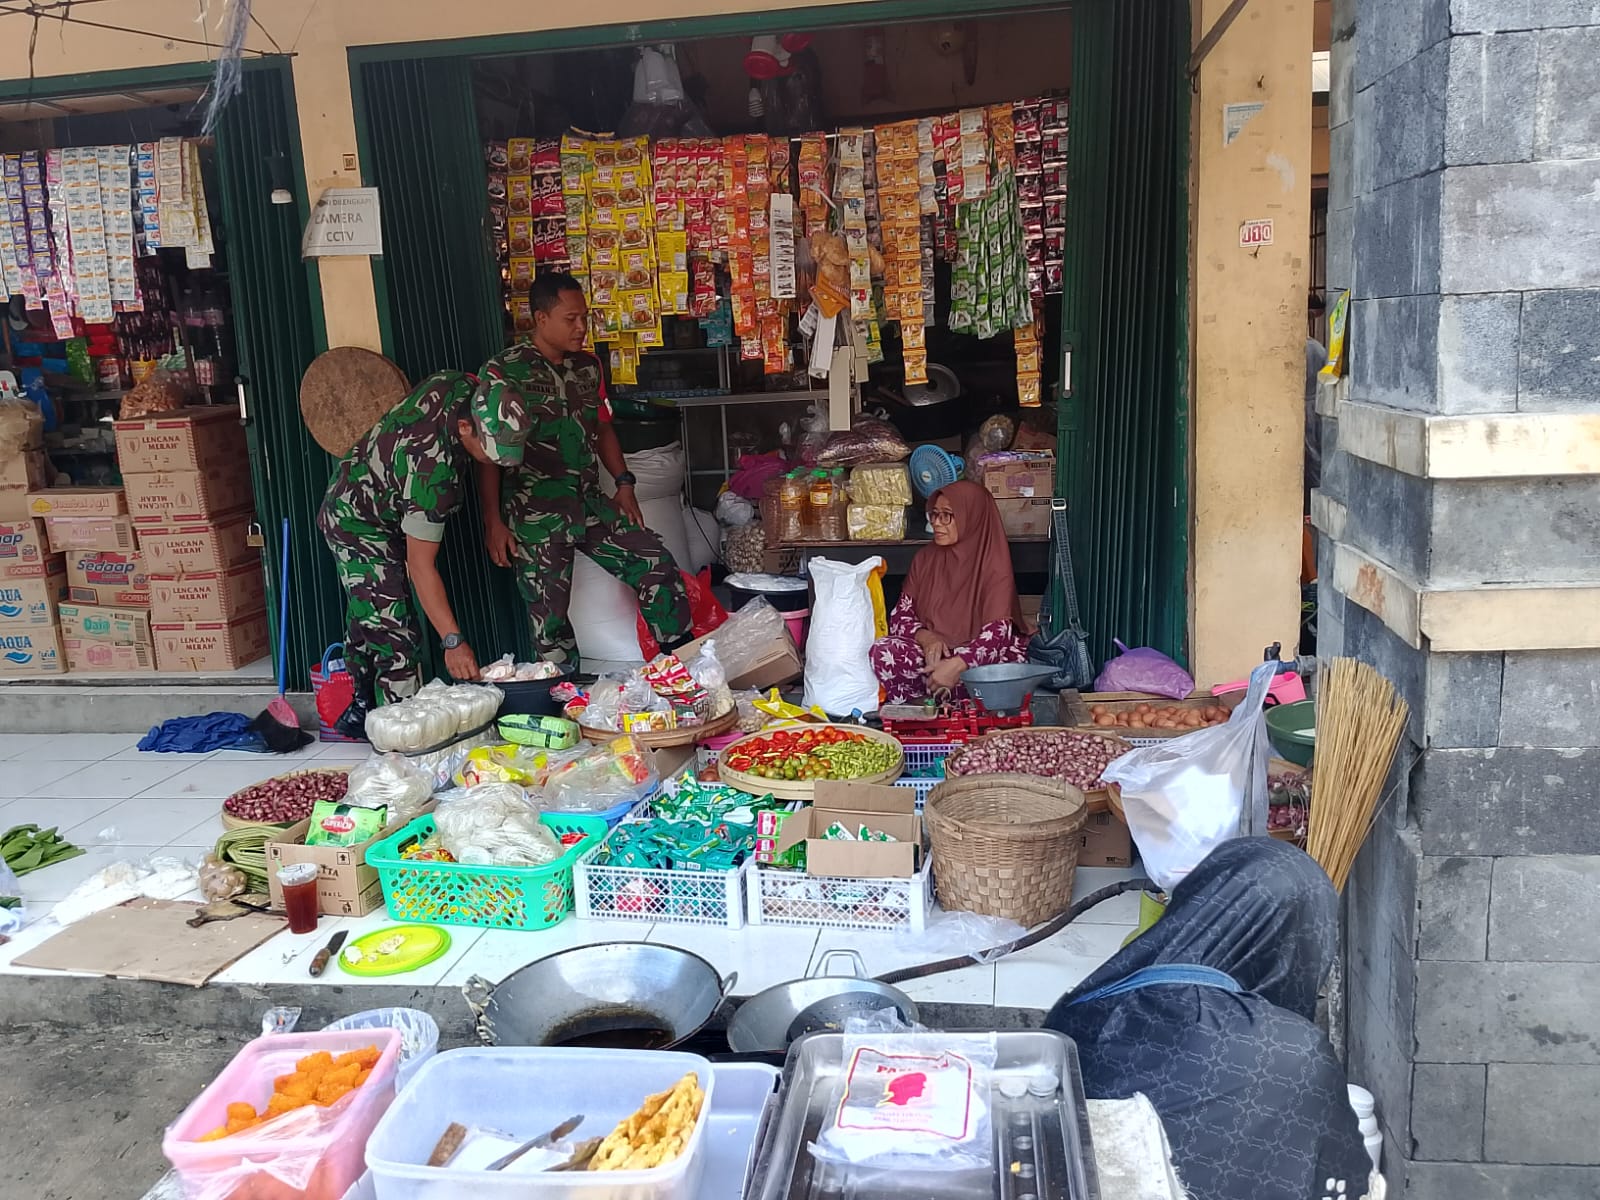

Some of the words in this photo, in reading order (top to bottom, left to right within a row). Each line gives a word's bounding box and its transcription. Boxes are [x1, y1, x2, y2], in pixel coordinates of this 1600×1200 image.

[314, 212, 363, 225] CAMERA
[326, 231, 354, 242] CCTV
[142, 435, 180, 443] LENCANA
[166, 540, 204, 548] LENCANA
[77, 559, 135, 574] Sedaap
[173, 586, 211, 594] LENCANA
[180, 636, 217, 644] LENCANA
